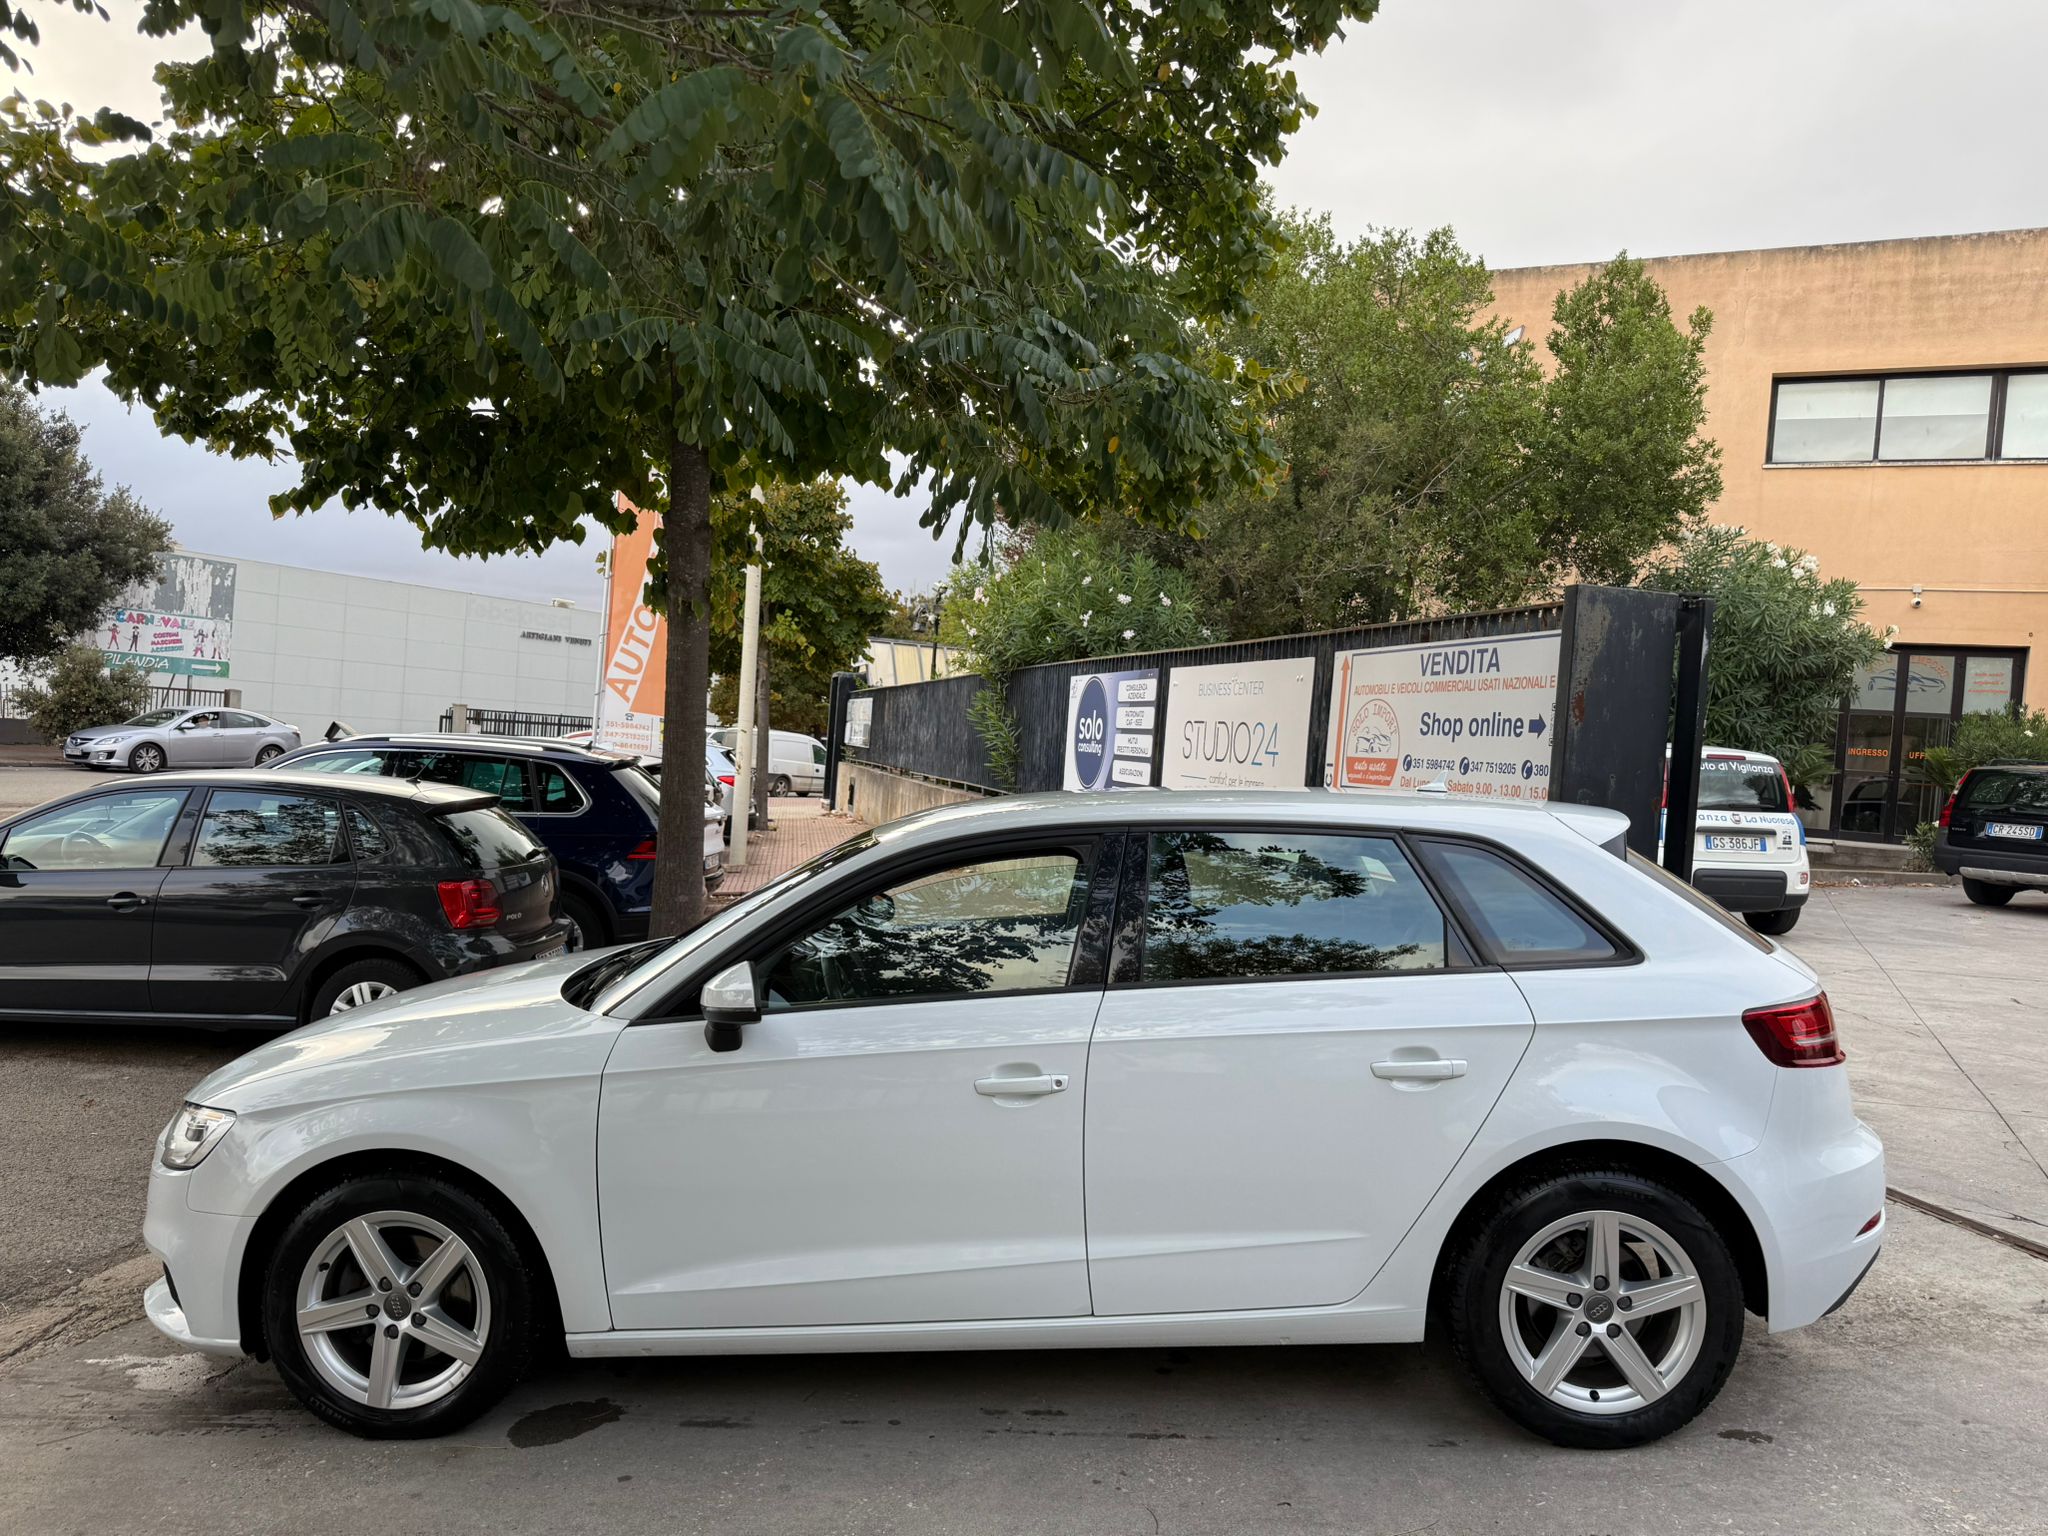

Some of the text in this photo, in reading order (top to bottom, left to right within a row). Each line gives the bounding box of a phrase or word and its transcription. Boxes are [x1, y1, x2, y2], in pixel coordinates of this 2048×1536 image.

[116, 610, 195, 631] CARNEVALE
[607, 603, 657, 703] AUTO
[1420, 647, 1500, 677] VENDITA
[1198, 680, 1265, 697] BUSINESS CENTER
[1354, 674, 1557, 696] AUTOMOBILI E VEICOLI COMMERCIALI USATI NAZIONALI E
[1078, 709, 1104, 740] solo
[1419, 711, 1524, 743] Shop online
[1077, 740, 1103, 757] consulting
[1182, 720, 1280, 767] STUDIO24
[1847, 747, 1889, 758] INGRESSO
[1908, 751, 1927, 760] UFF
[1412, 758, 1456, 771] 351 5984742
[1470, 761, 1517, 775] 347 7519205
[1533, 764, 1549, 777] 380
[1718, 762, 1728, 771] di
[1729, 761, 1774, 774] Vigilanza
[1400, 775, 1412, 788] Dal
[1447, 779, 1474, 793] Sabato
[1475, 782, 1492, 796] 9.00
[1500, 783, 1521, 798] 13.00
[1529, 786, 1548, 800] 15.0
[1698, 813, 1796, 826] anza La Nuorese
